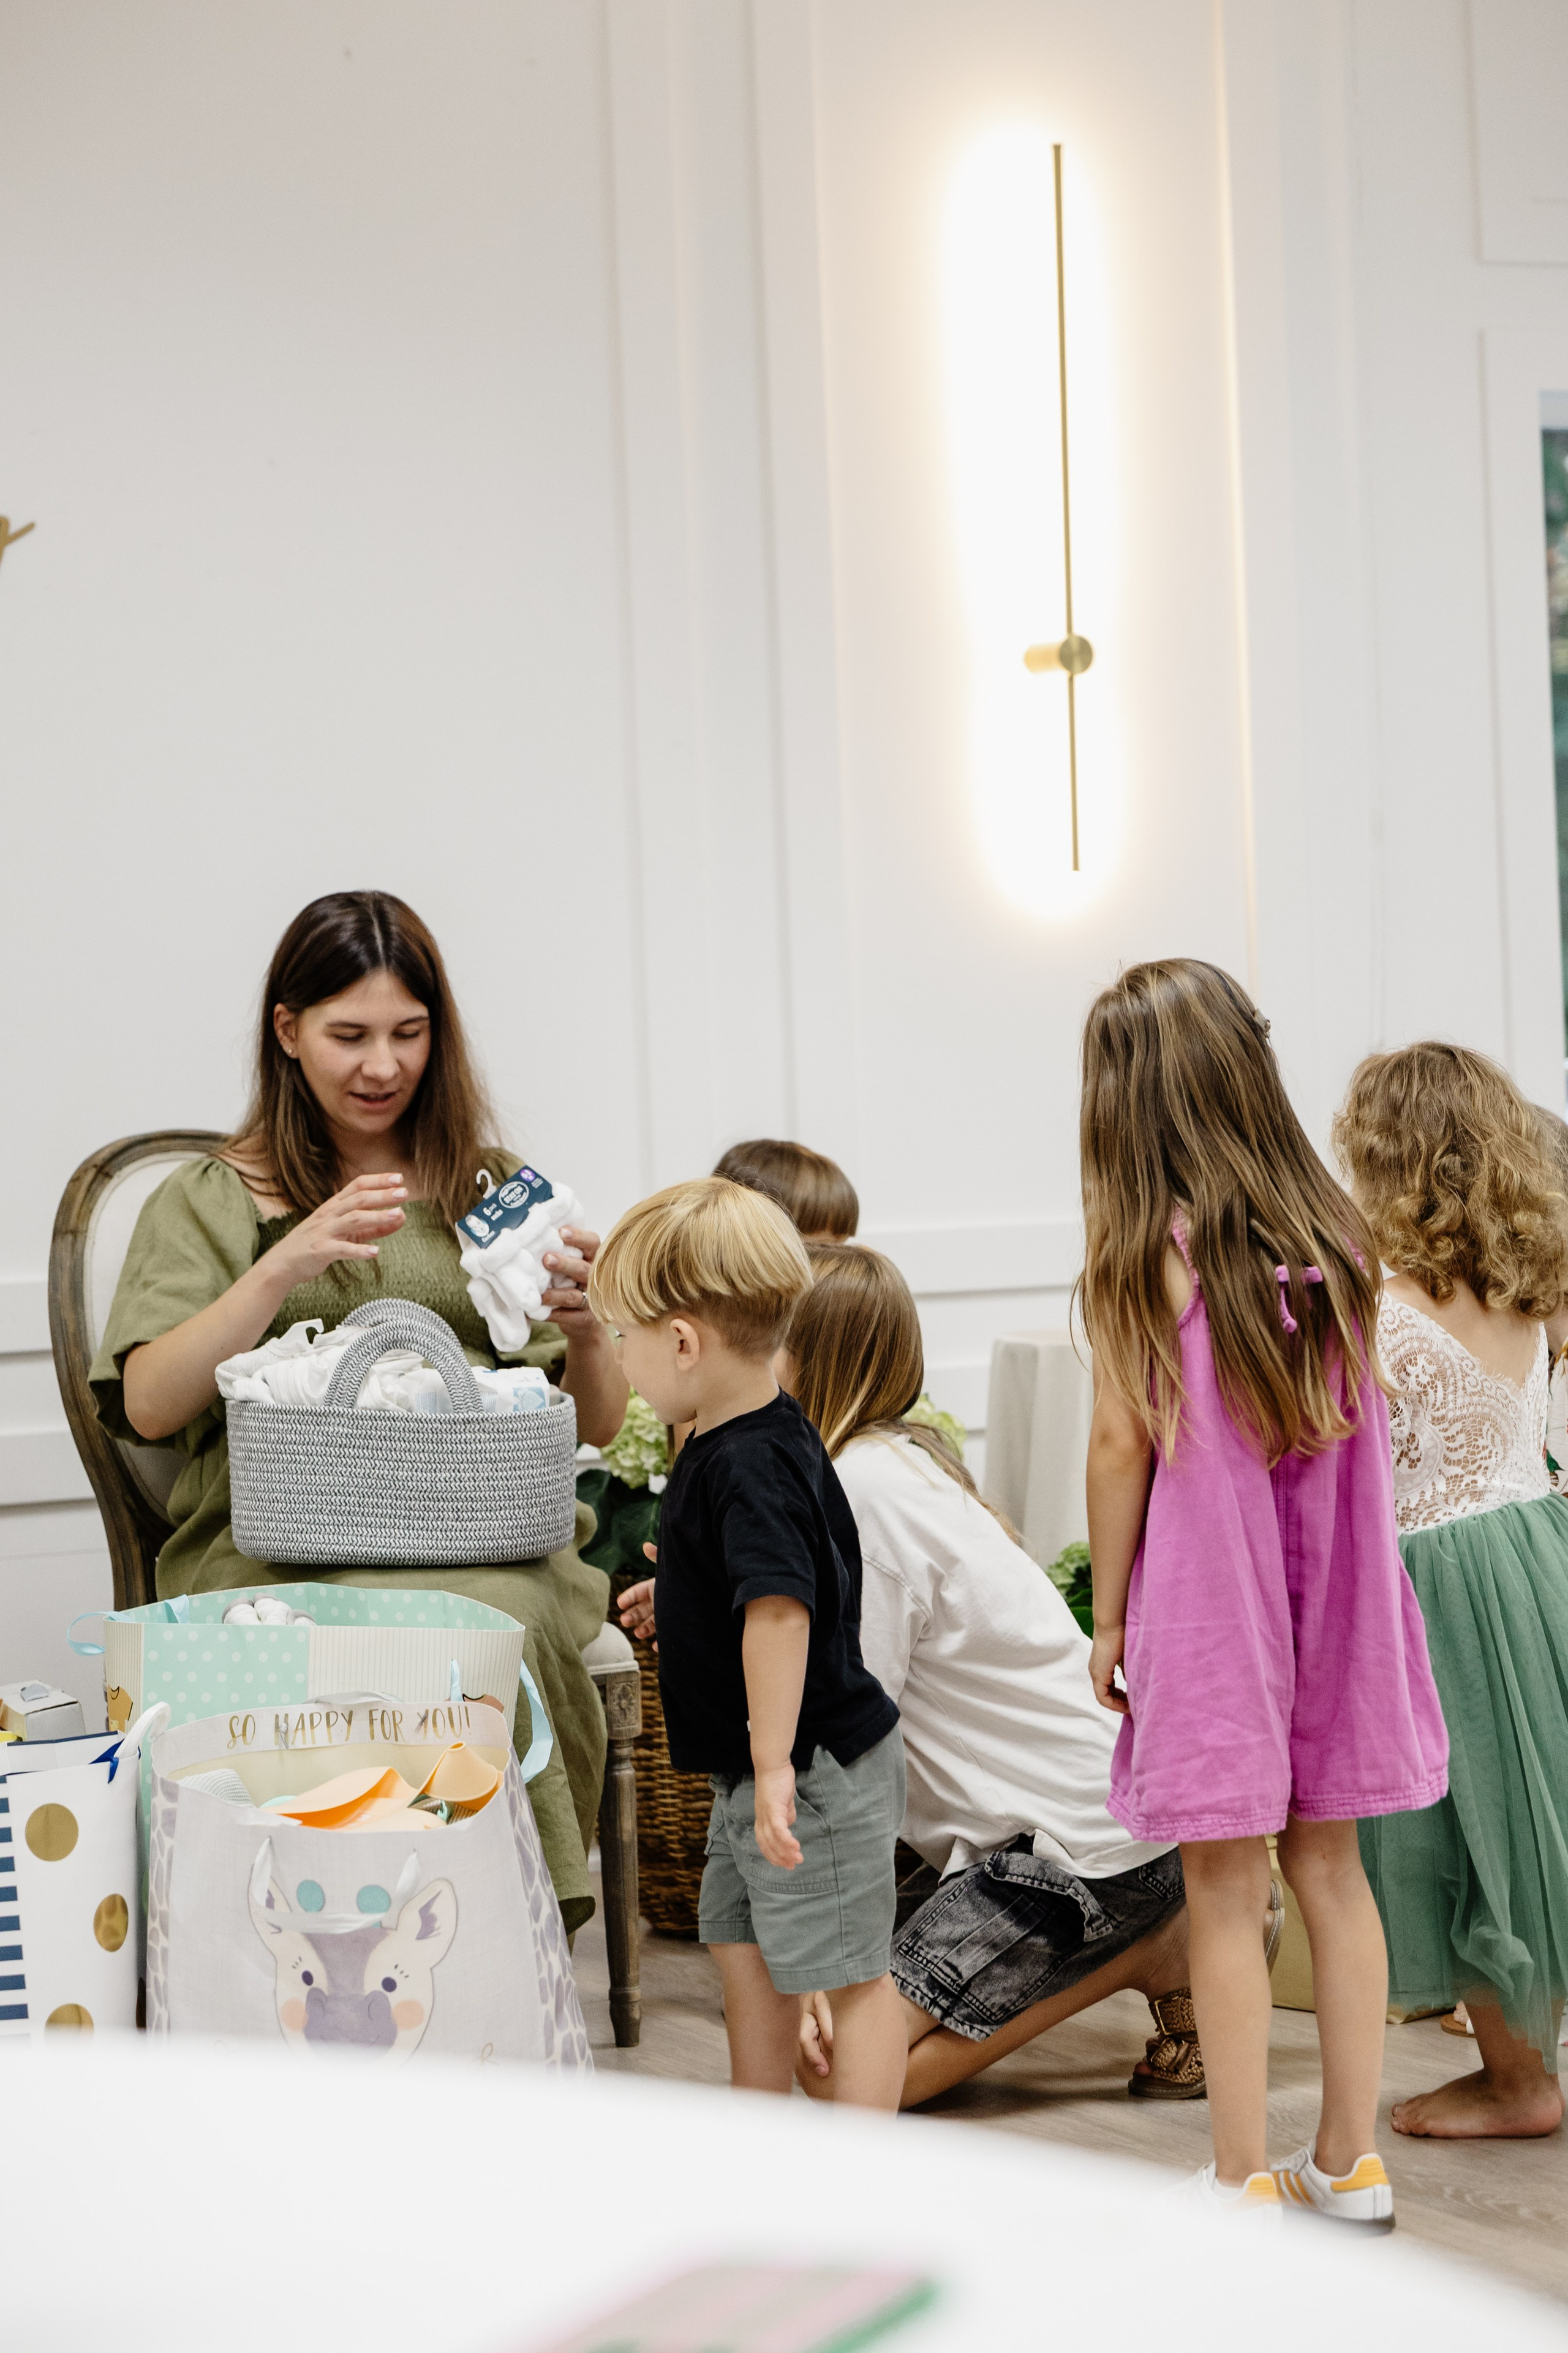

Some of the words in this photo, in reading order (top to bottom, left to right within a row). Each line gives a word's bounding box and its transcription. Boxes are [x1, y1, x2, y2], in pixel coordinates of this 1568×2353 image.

[503, 1190, 516, 1204] STAY
[514, 1185, 524, 1195] ON
[483, 1207, 491, 1216] 6
[227, 1715, 255, 1749] SO
[274, 1710, 353, 1747] HAPPY
[369, 1709, 406, 1745] FOR
[417, 1705, 471, 1740] YOU!
